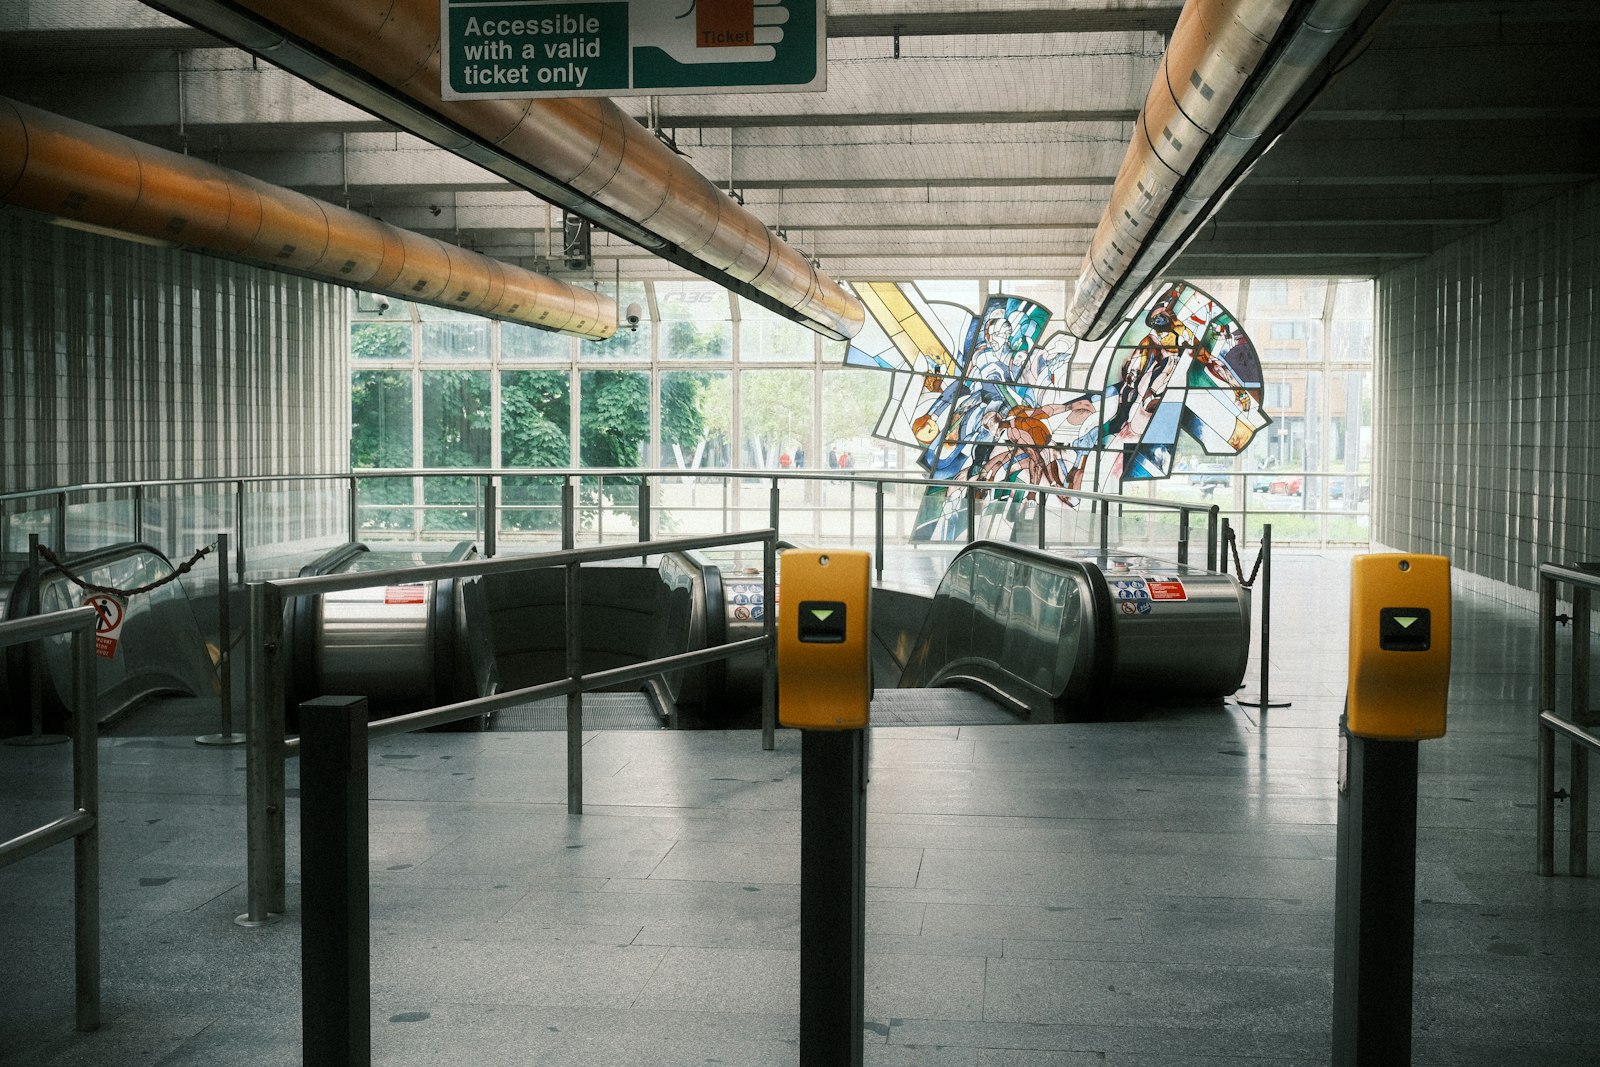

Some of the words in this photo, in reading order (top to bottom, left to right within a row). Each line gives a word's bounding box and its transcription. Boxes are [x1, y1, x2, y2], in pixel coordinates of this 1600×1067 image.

[464, 14, 600, 36] Accessible
[702, 31, 750, 43] Ticket
[464, 40, 513, 60] with
[521, 43, 535, 59] a
[544, 38, 600, 59] valid
[464, 64, 529, 85] ticket
[537, 62, 588, 87] only
